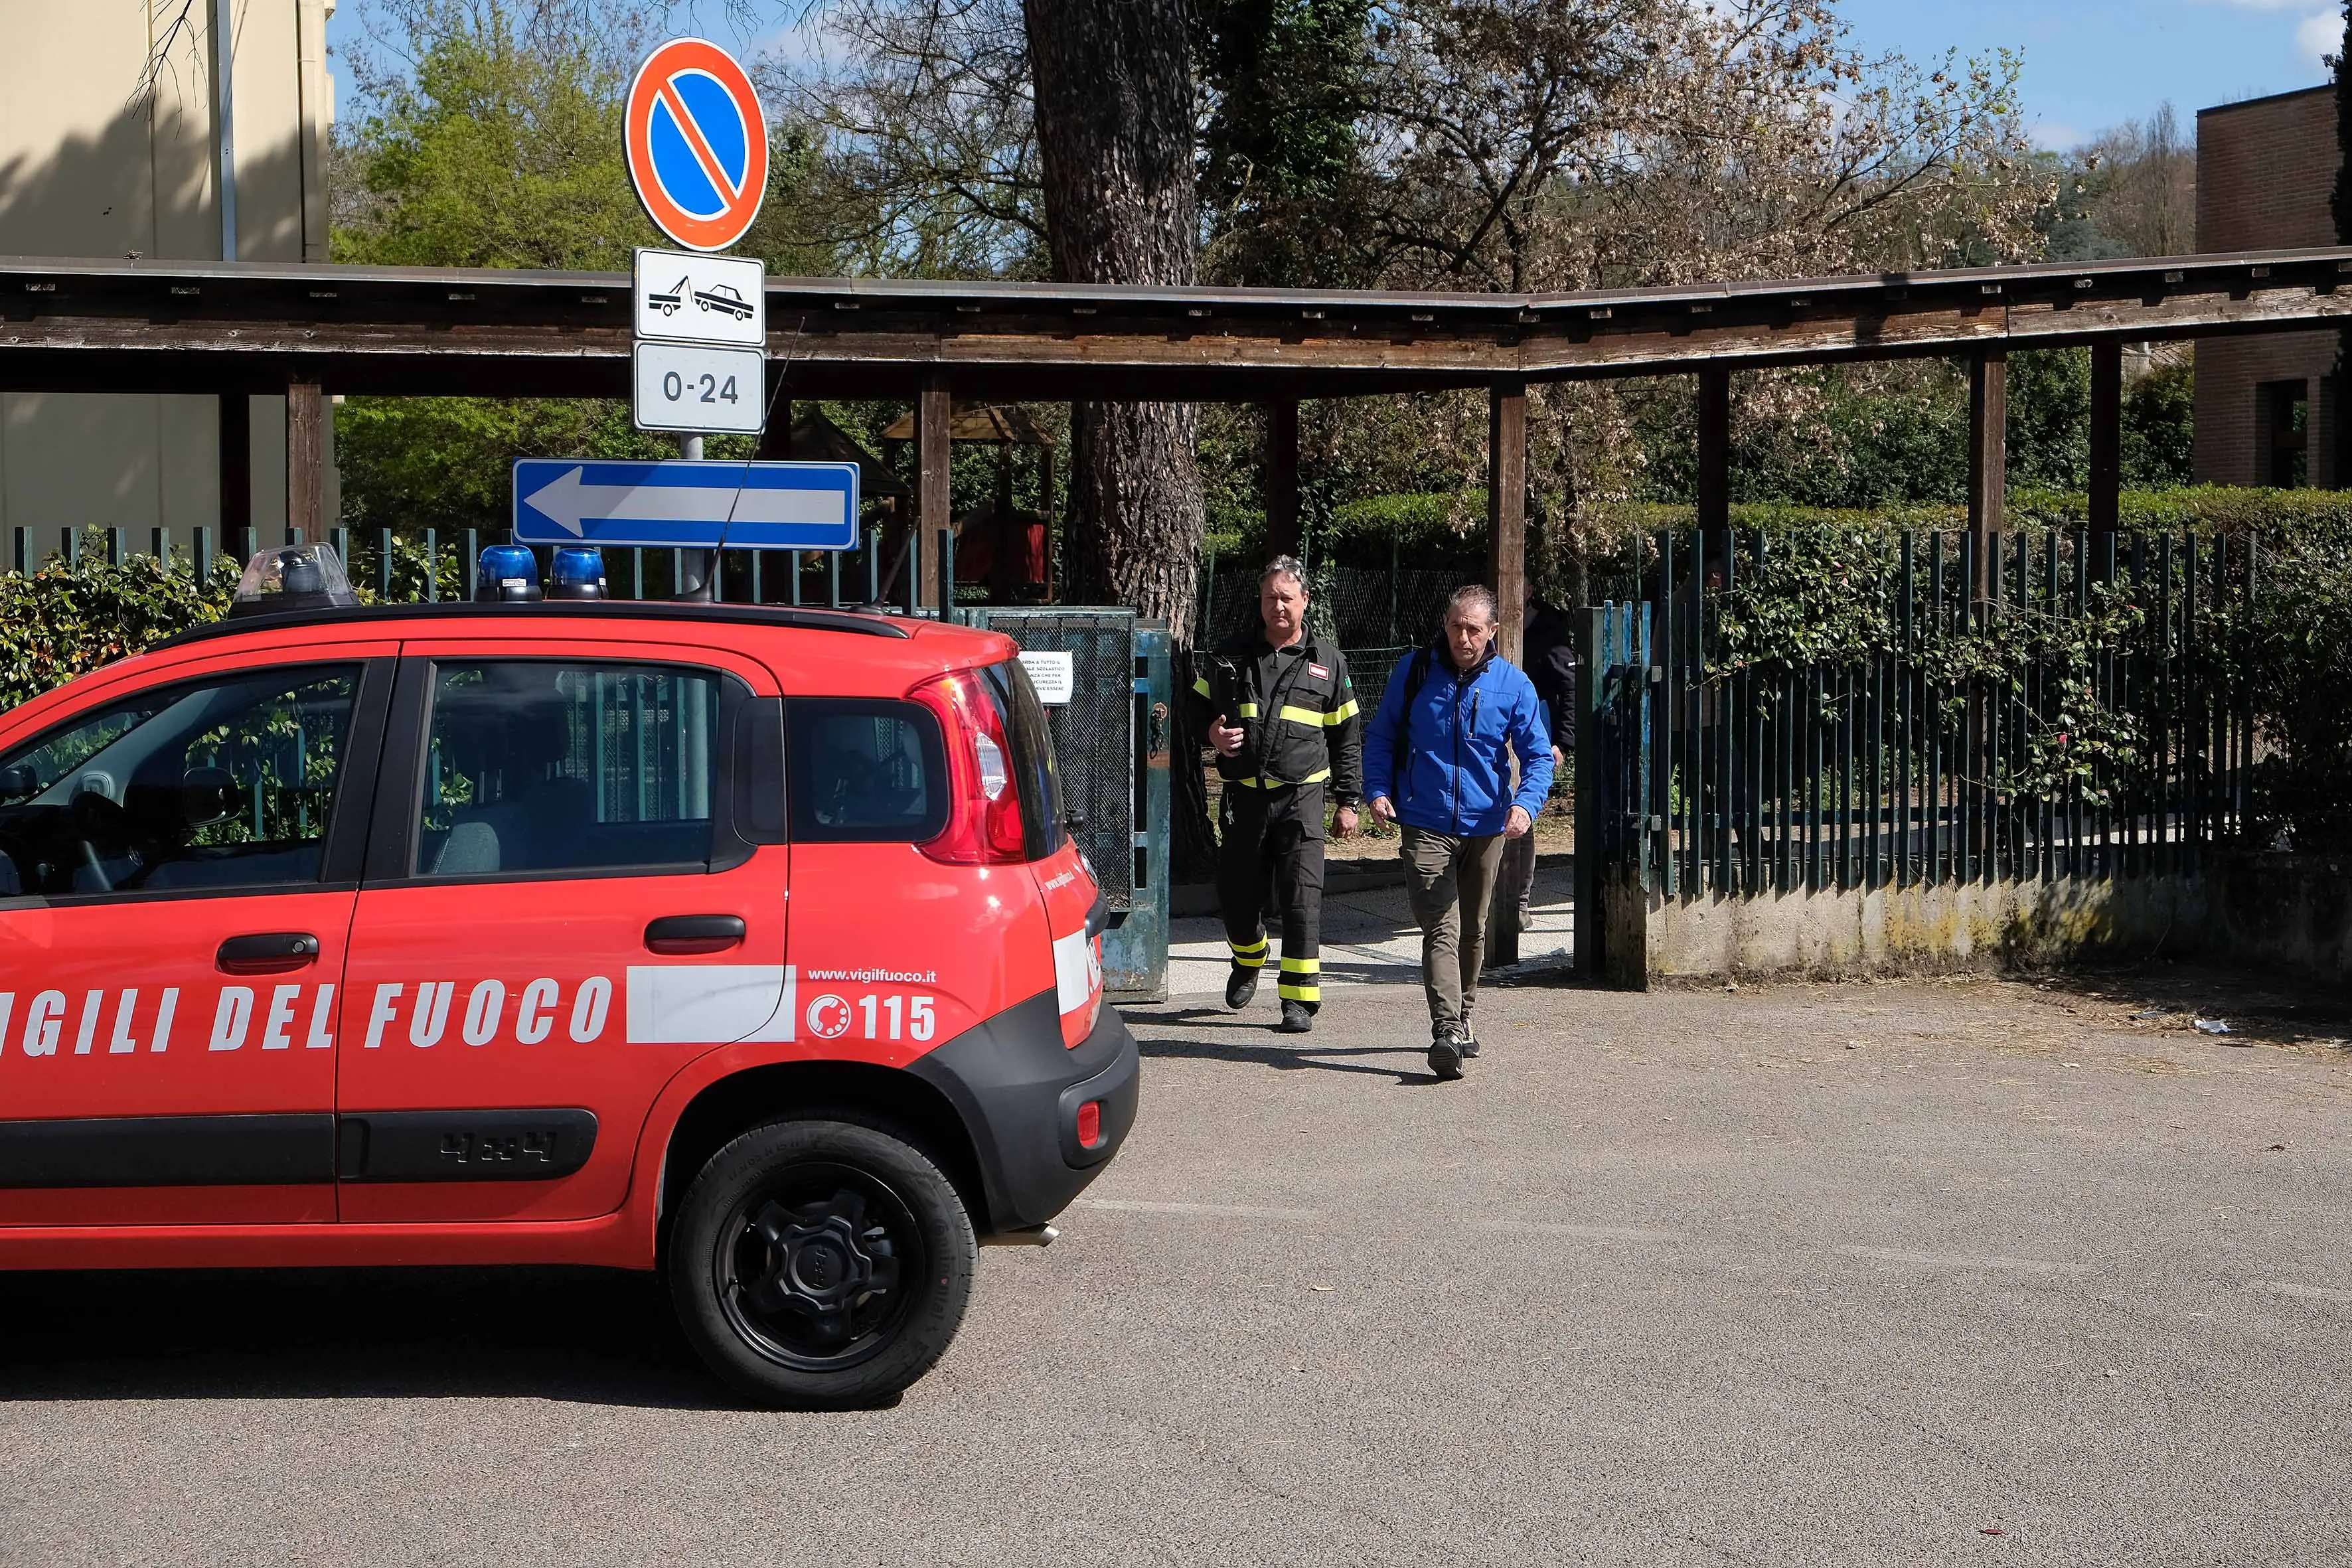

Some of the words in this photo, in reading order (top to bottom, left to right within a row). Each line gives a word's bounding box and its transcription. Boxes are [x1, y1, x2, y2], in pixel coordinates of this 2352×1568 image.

[663, 371, 738, 404] 0-24
[808, 968, 937, 984] www.vigilfuoco.it
[208, 983, 335, 1052] DEL
[363, 976, 613, 1049] FUOCO
[858, 994, 935, 1041] 115
